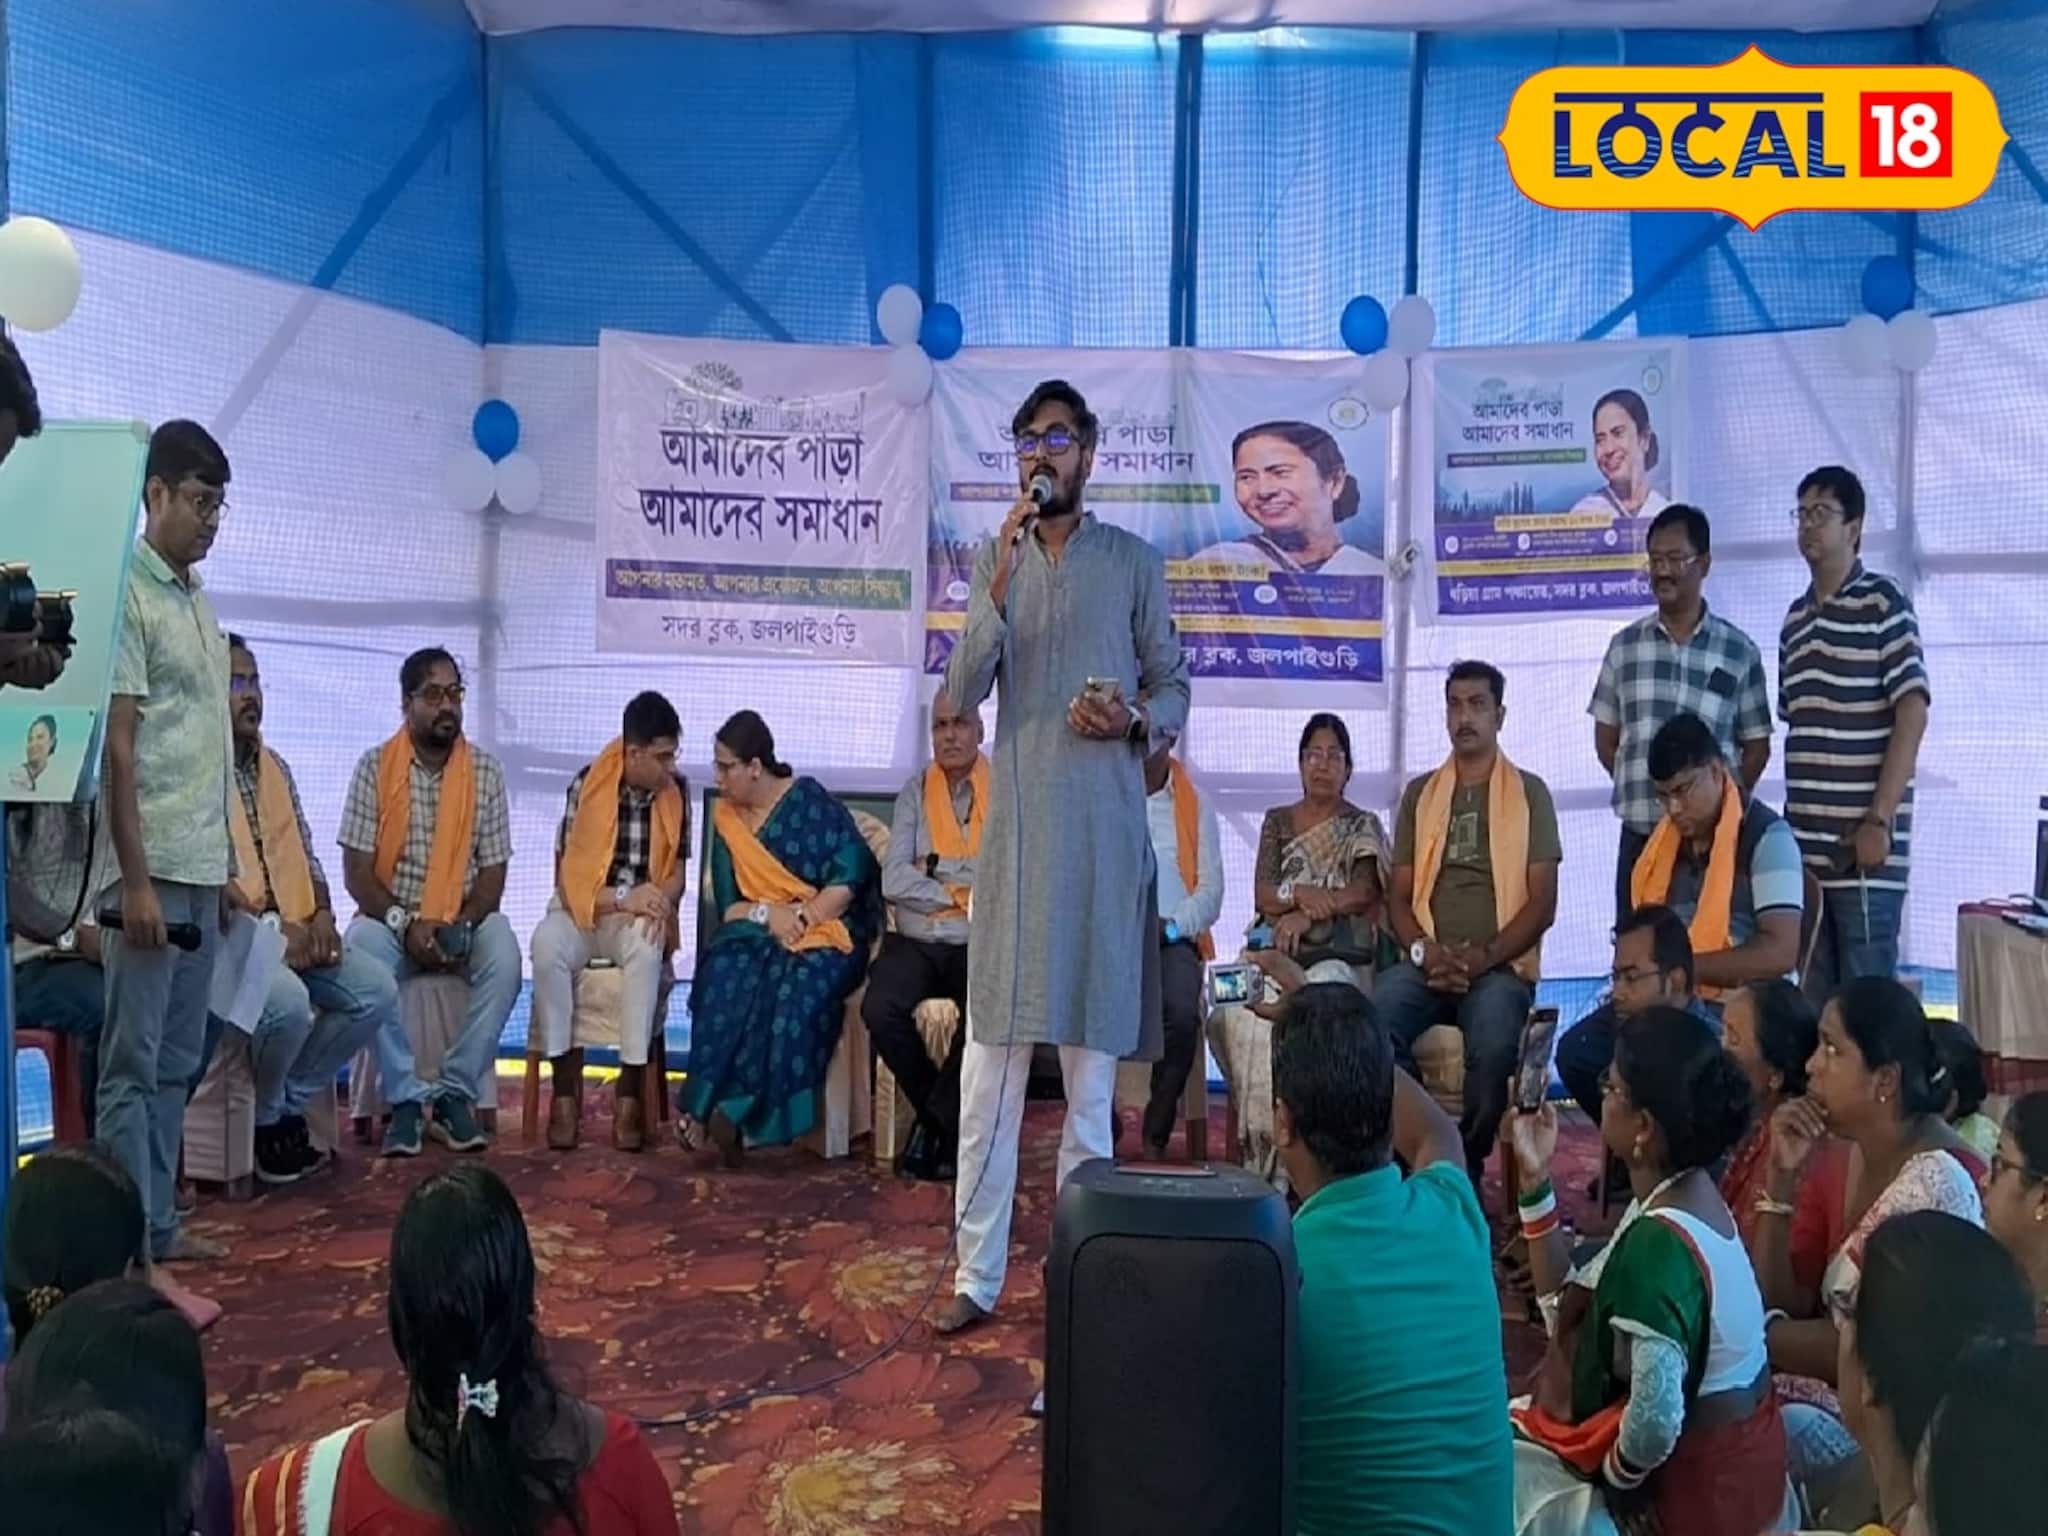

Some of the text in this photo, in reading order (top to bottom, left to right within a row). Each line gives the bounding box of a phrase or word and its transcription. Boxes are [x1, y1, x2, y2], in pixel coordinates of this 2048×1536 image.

[1472, 400, 1529, 420] আমাদের
[1118, 424, 1175, 446] পাড়া
[1462, 421, 1574, 442] আমাদের সমাধান
[660, 428, 863, 484] আমাদের পাড়া
[1100, 452, 1194, 472] সমাধান
[639, 485, 882, 544] আমাদের সমাধান
[662, 614, 857, 649] সদর ব্লক, জলপাইগুড়ি
[1247, 645, 1360, 670] জলপাইগুড়ি
